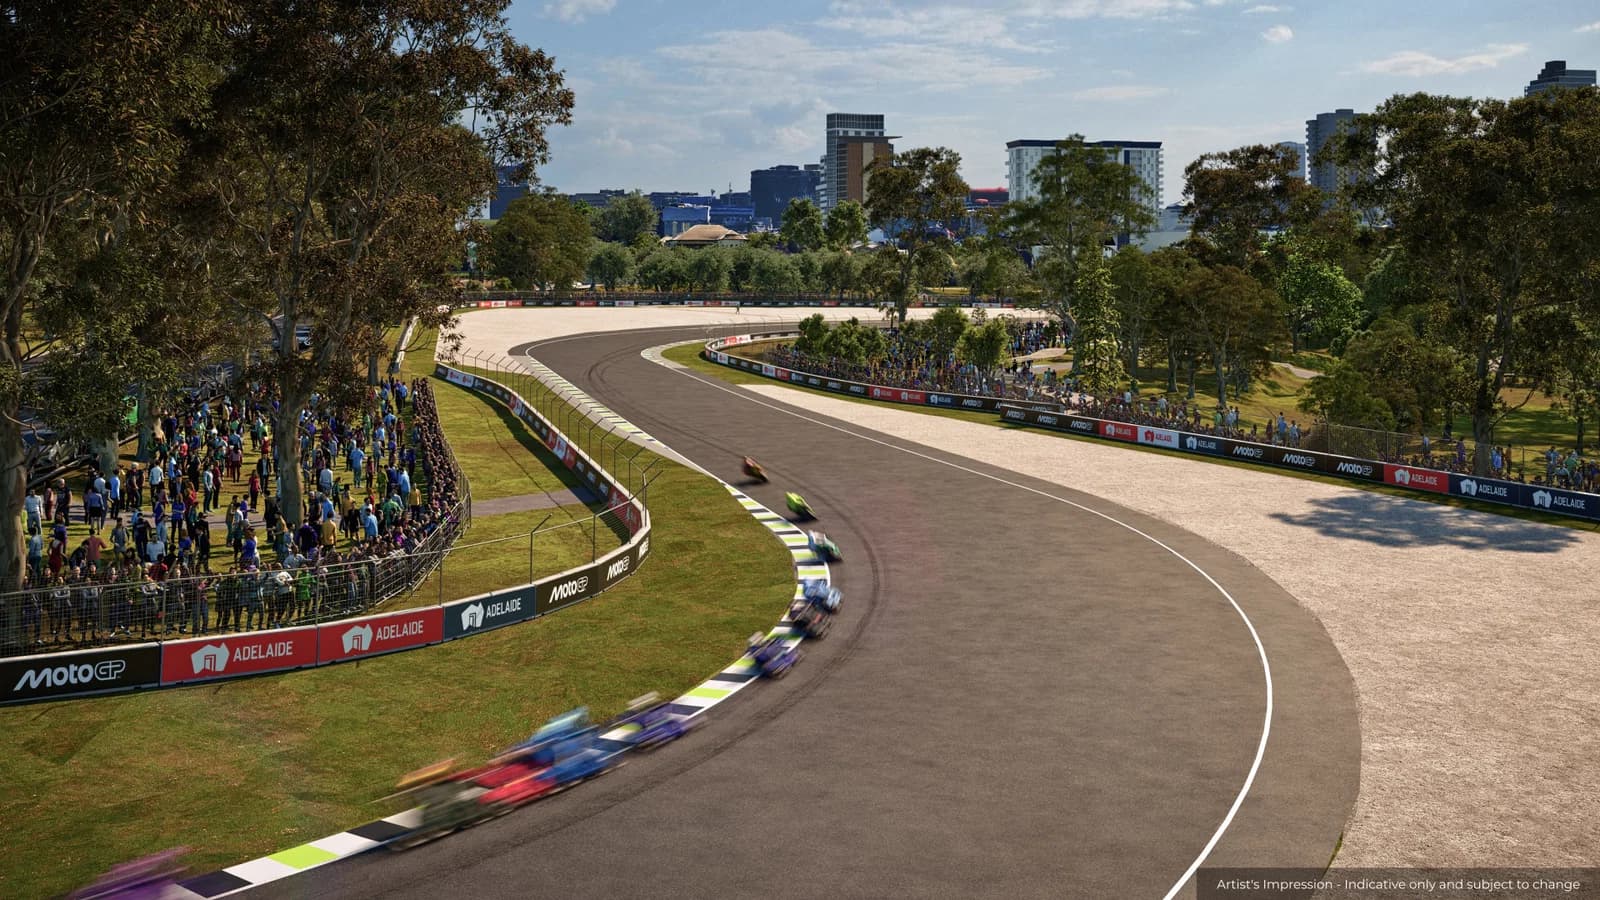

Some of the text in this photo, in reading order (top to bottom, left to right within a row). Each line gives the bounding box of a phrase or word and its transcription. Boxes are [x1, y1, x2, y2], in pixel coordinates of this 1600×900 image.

[1411, 473, 1438, 486] ADELAIDE
[1478, 483, 1508, 497] ADELAIDE
[1552, 494, 1586, 510] ADELAIDE
[486, 598, 522, 618] ADELAIDE
[376, 620, 425, 641] ADELAIDE
[233, 641, 294, 662] ADELAIDE
[13, 659, 126, 691] MotoGP
